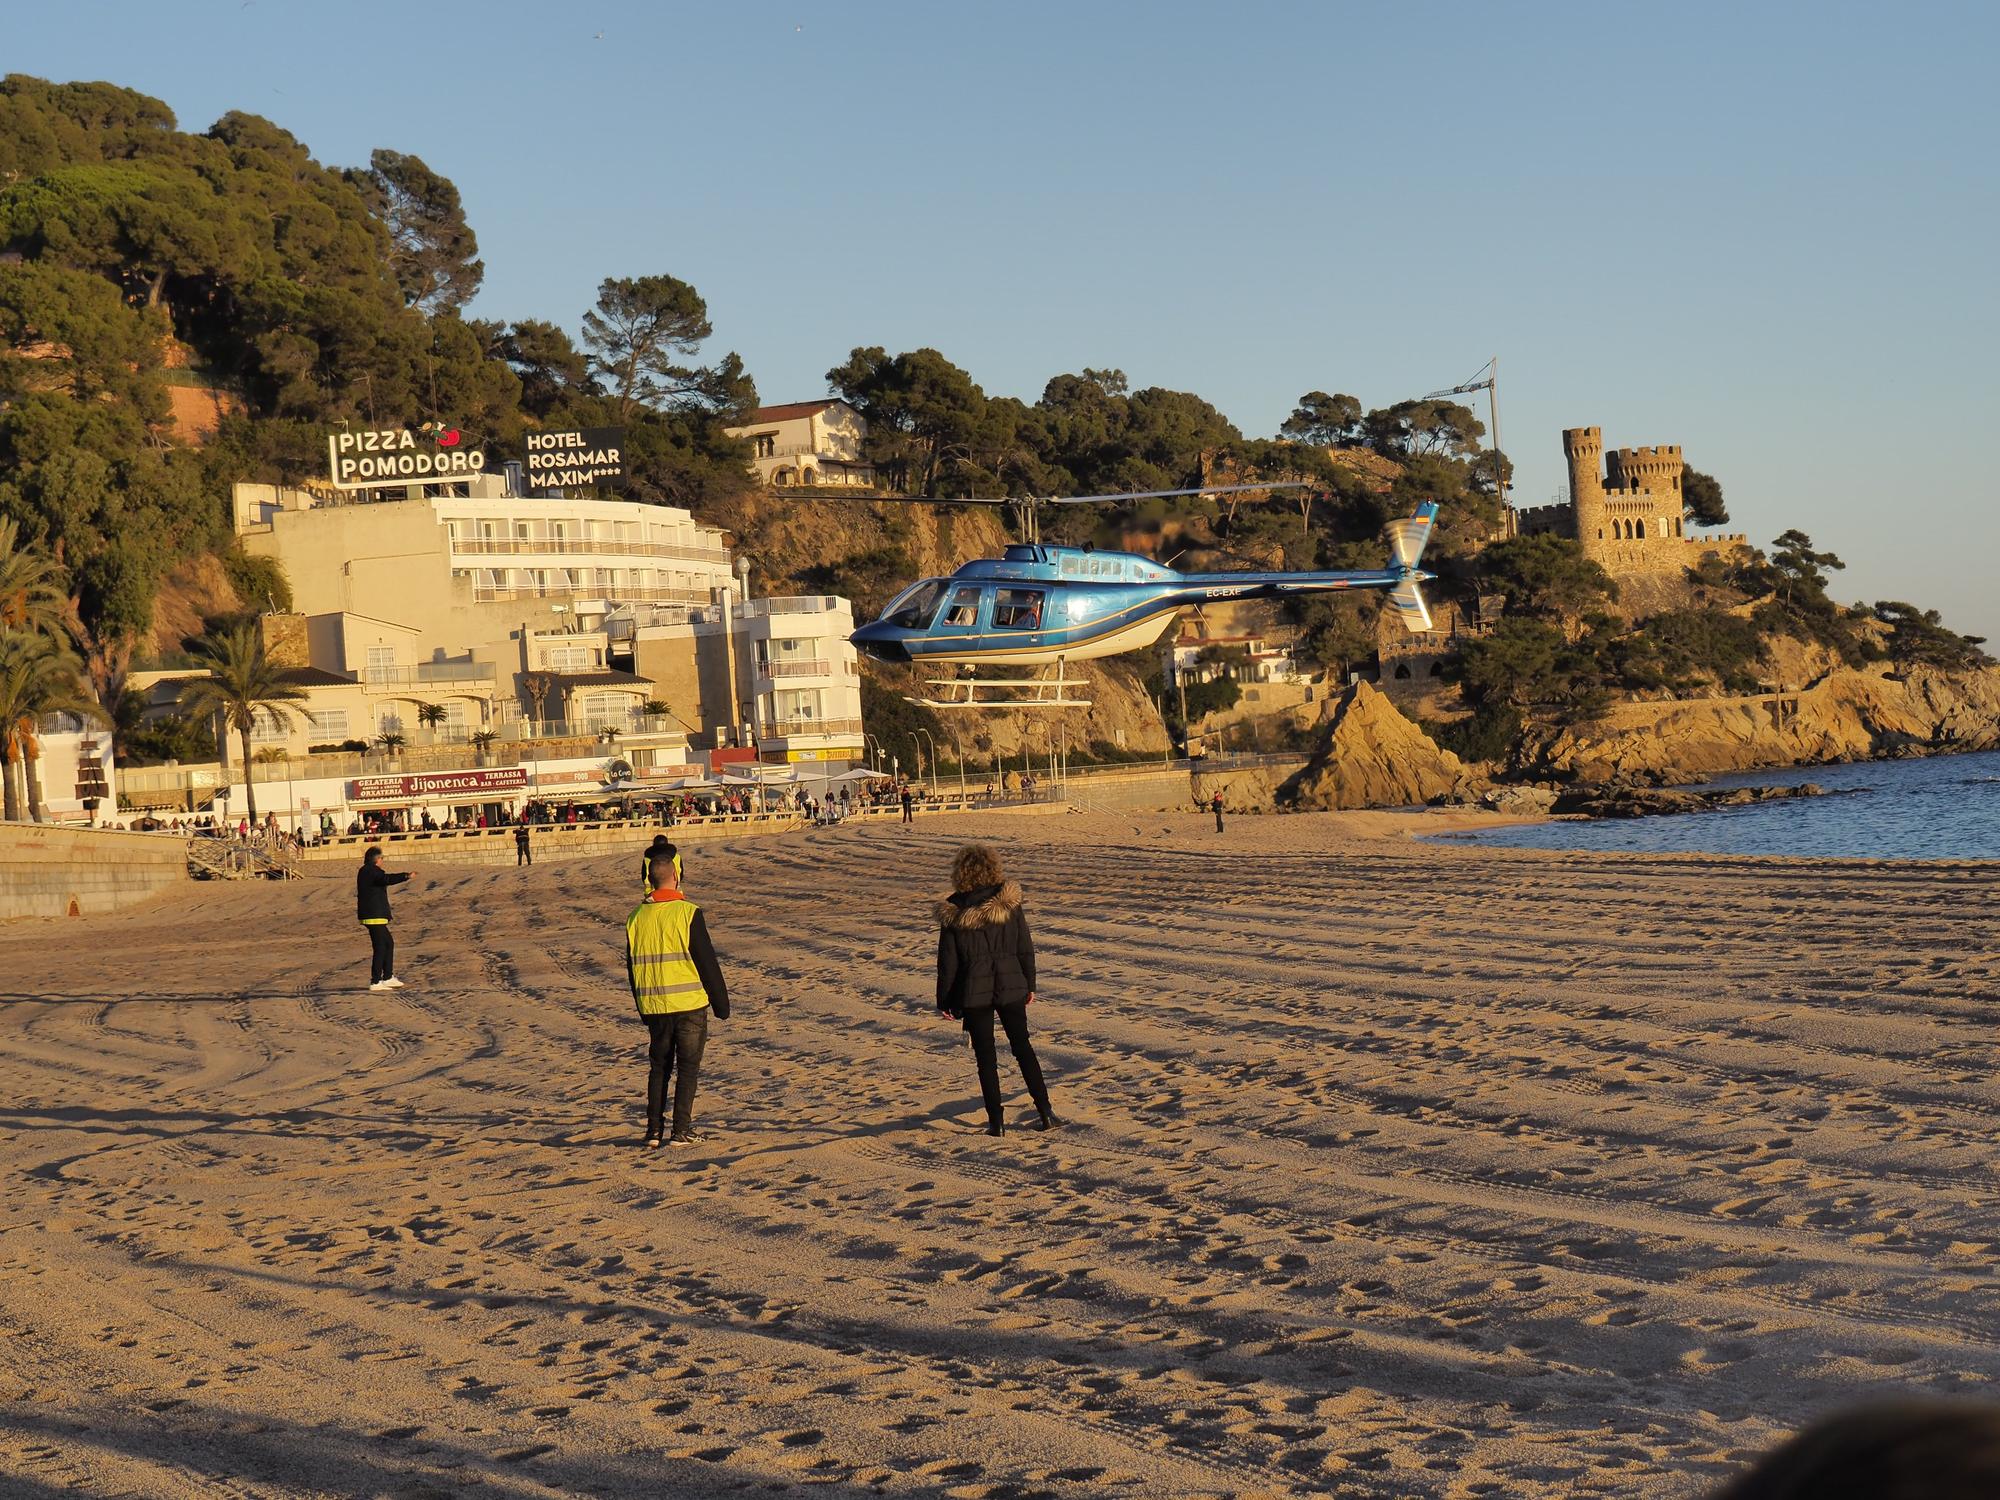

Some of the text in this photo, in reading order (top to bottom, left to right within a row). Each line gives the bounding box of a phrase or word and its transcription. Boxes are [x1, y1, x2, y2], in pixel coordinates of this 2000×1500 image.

[340, 430, 416, 453] PIZZA
[527, 432, 587, 450] HOTEL
[342, 451, 485, 479] POMODORO
[529, 449, 621, 470] ROSAMAR
[358, 778, 404, 787] GELATERIA
[484, 770, 522, 780] TERRASSA
[574, 772, 589, 781] FOOD
[360, 788, 403, 797] ORXATERIA
[410, 777, 479, 793] Jijonenca
